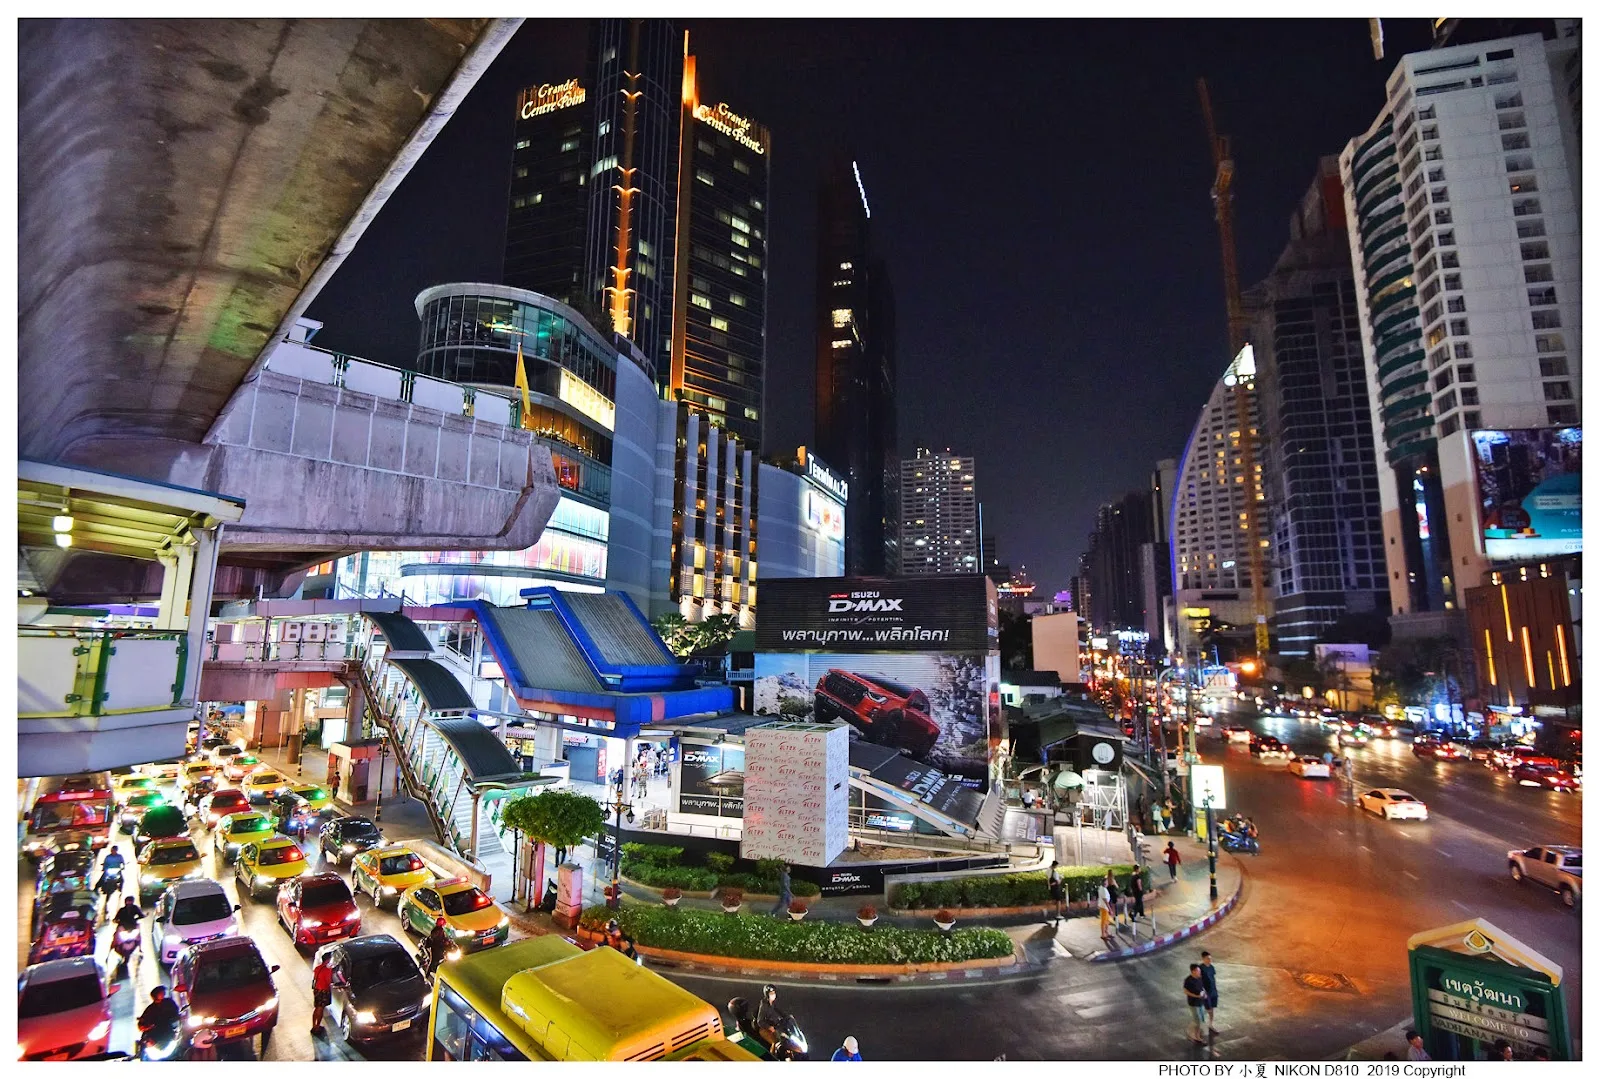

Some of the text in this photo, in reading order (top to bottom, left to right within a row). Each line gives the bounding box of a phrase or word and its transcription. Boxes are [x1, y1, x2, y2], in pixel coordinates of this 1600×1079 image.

[538, 78, 577, 98] Grande
[521, 88, 586, 120] Centre Point
[719, 103, 751, 130] Grande
[699, 104, 764, 154] Centre Point
[828, 599, 904, 613] D-MAX
[1445, 979, 1521, 1008] เขตวัฒนา
[1449, 1009, 1529, 1038] WELCOME TO
